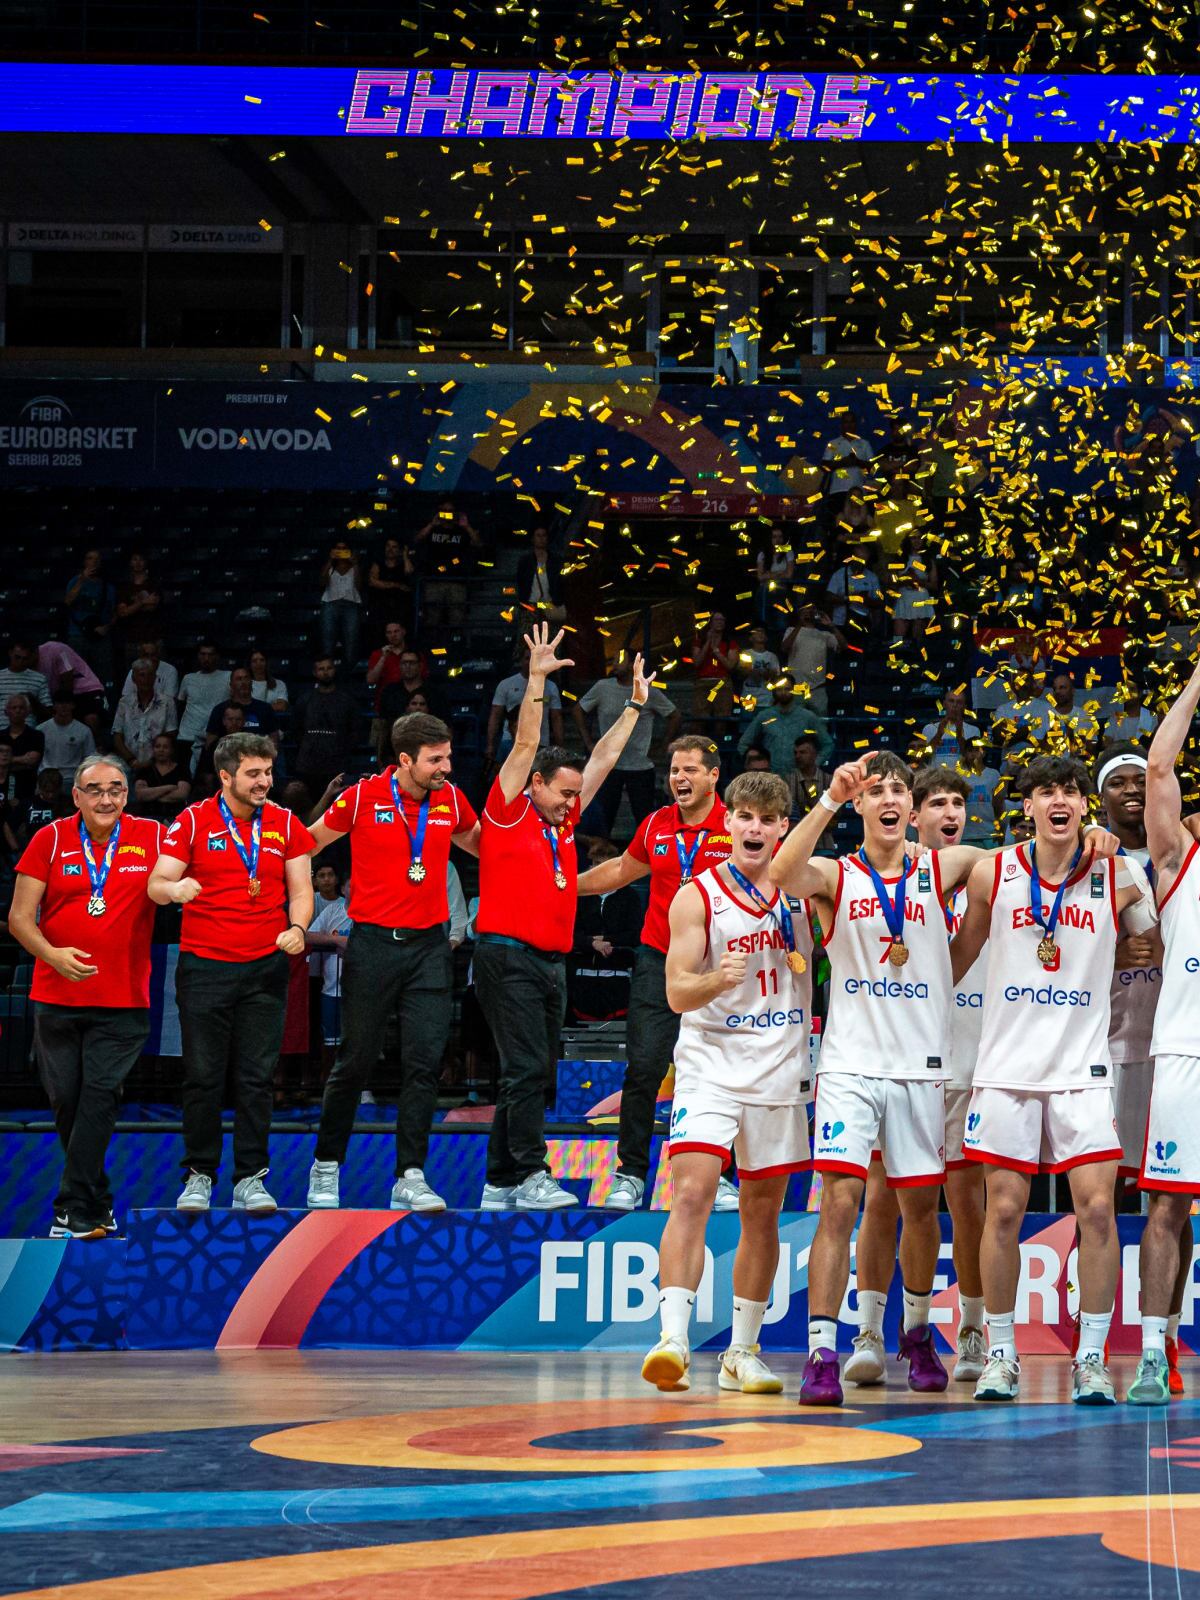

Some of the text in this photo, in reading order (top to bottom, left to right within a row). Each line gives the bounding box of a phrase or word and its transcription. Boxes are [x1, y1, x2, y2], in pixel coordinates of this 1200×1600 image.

[346, 69, 872, 139] CHAMPIONS
[29, 229, 136, 241] DELTA HOLDING
[181, 231, 225, 243] DELTA
[226, 394, 289, 404] PRESENTED BY
[30, 407, 61, 422] FIBA
[0, 427, 137, 450] EUROBASKET
[178, 428, 333, 451] VODAVODA
[8, 454, 83, 467] SERBIA 2025
[701, 500, 729, 513] 216
[117, 845, 146, 859] ESPAÑA
[118, 865, 148, 873] endesa
[849, 896, 926, 927] ESPÑA
[756, 968, 778, 997] 11
[844, 977, 928, 999] endesa
[1004, 985, 1092, 1007] endesa
[725, 1007, 804, 1028] endesa
[1150, 1164, 1181, 1175] tenerife!
